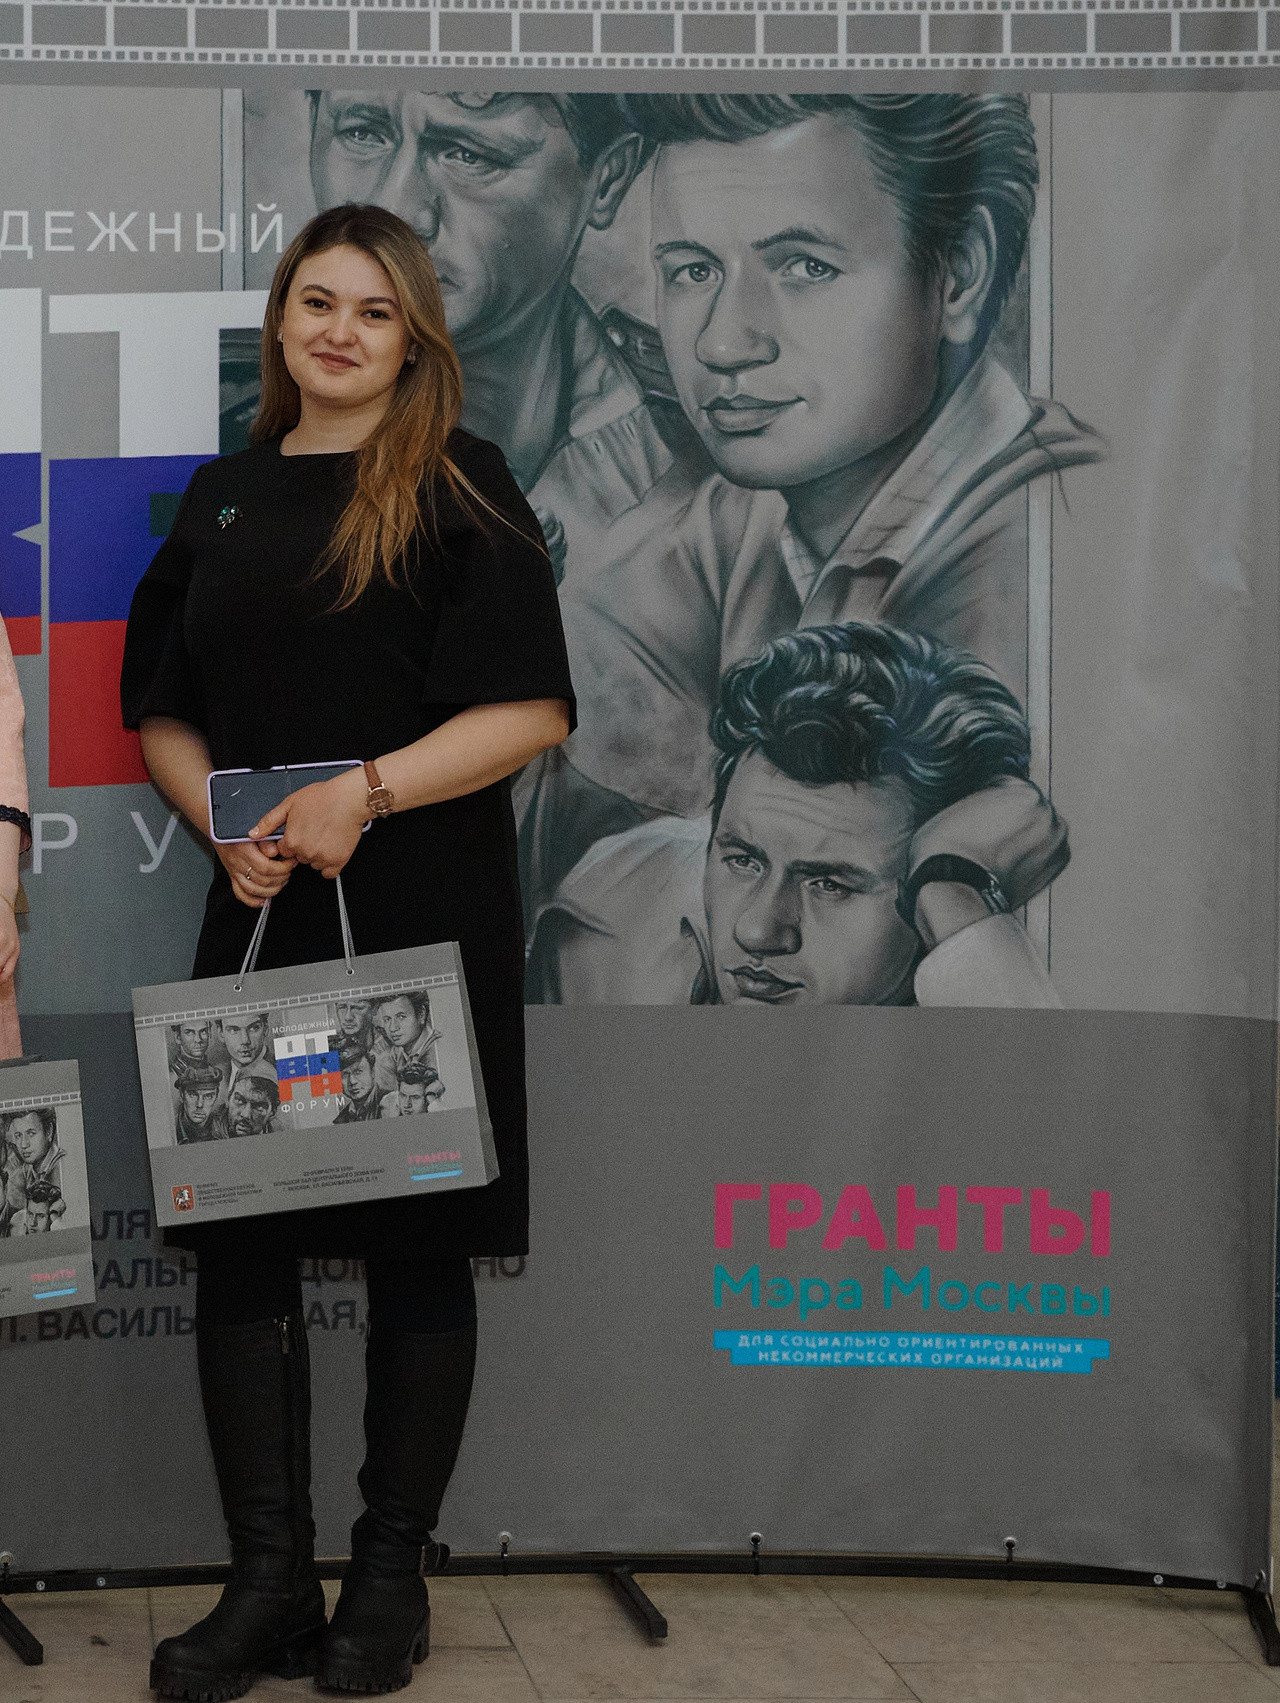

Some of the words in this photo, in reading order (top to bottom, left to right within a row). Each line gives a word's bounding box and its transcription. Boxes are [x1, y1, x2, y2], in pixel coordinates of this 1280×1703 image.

[281, 1096, 345, 1113] ФОРУМ
[714, 1183, 1112, 1257] ГРАНТЫ
[714, 1264, 863, 1321] Мэра
[883, 1266, 1111, 1318] Москвы
[737, 1334, 774, 1349] ДЛЯ
[780, 1334, 891, 1350] СОЦИАЛЬНО
[897, 1336, 1084, 1354] ОРИЕНТИРОВАННЫХ
[758, 1350, 923, 1365] НЕКОММЕРЧЕСКИХ
[930, 1352, 1065, 1370] ОРГАНИЗАЦИЙ
